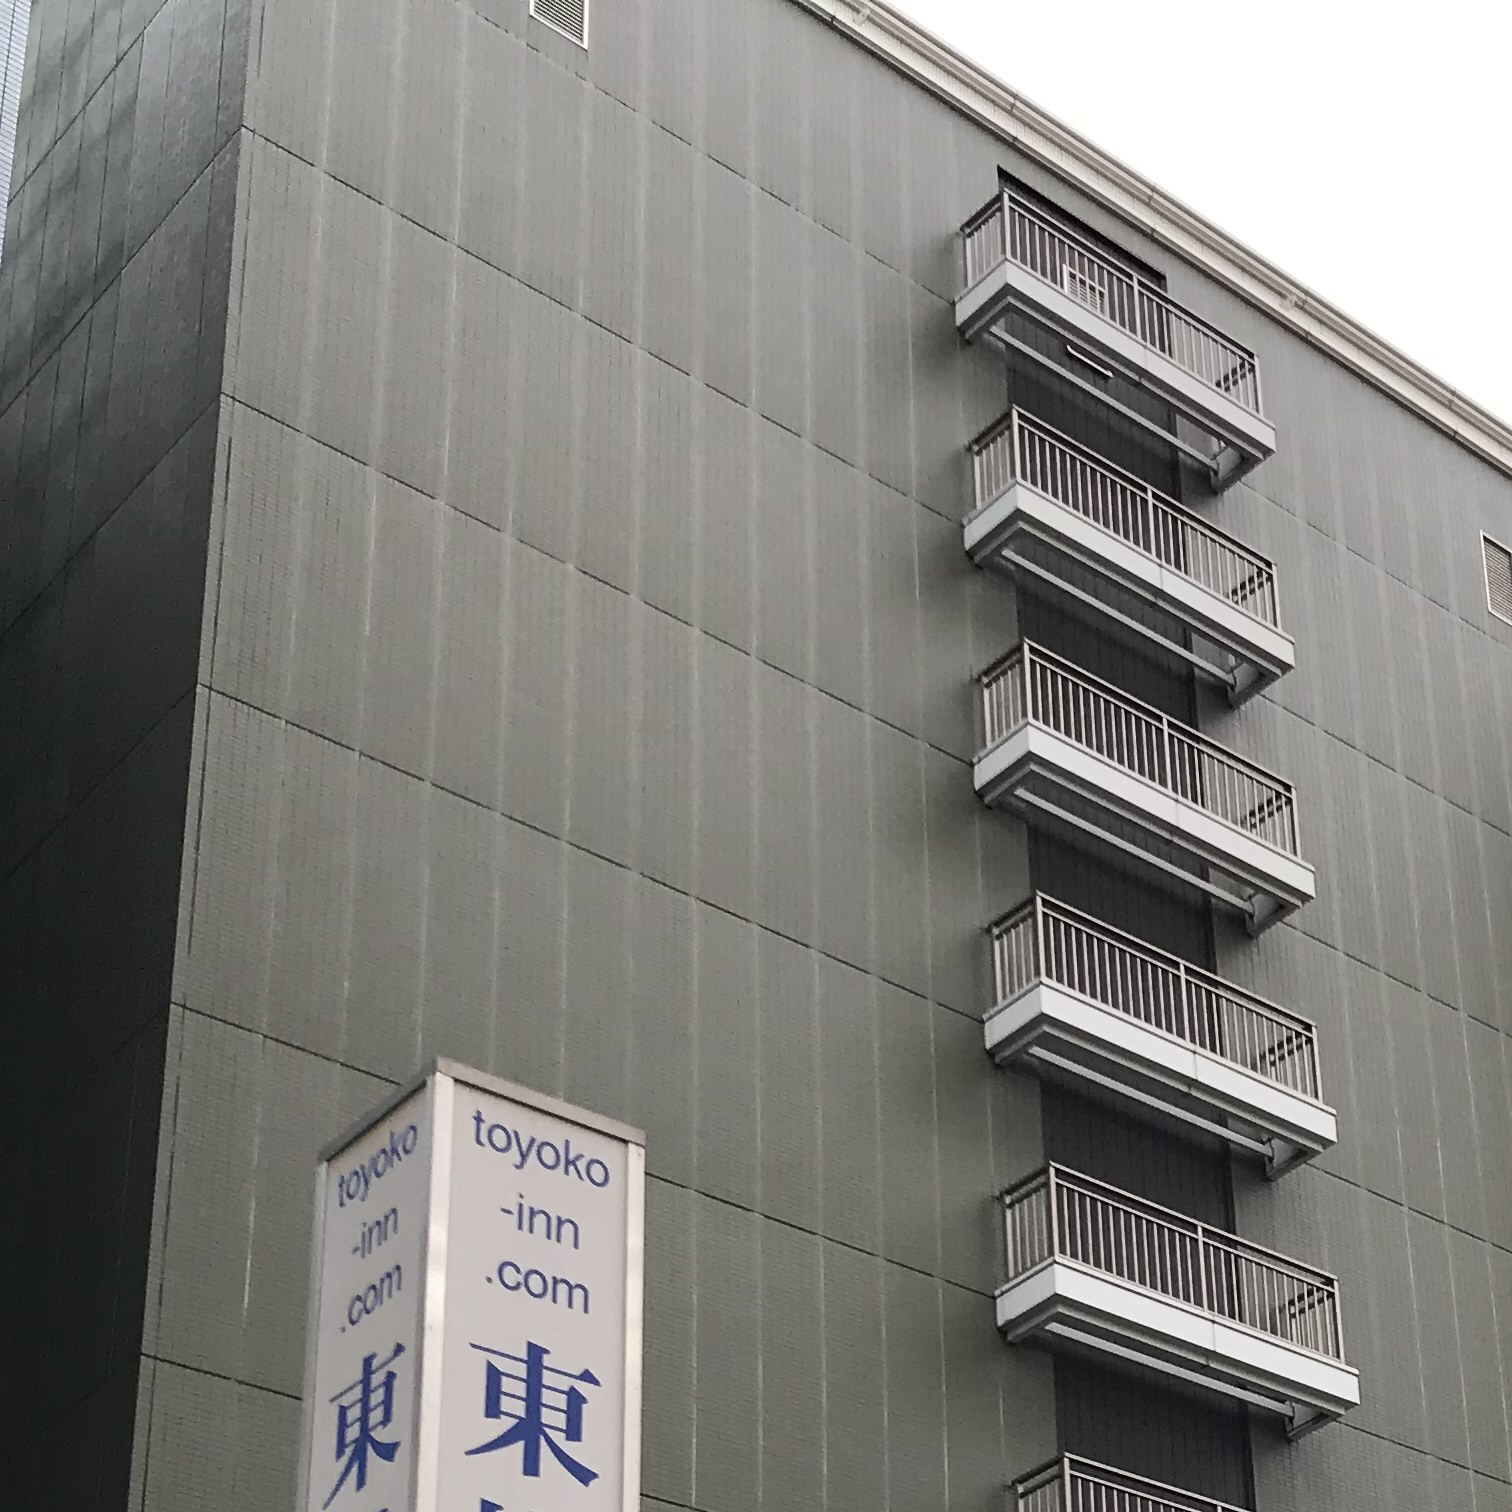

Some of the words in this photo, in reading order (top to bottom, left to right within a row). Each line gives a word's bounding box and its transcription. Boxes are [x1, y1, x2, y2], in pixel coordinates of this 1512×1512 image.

[337, 1123, 418, 1208] toyoko
[471, 1110, 610, 1188] toyoko
[351, 1206, 399, 1259] -inn
[501, 1194, 581, 1250] -inn
[339, 1264, 403, 1333] .com
[486, 1260, 590, 1314] .com
